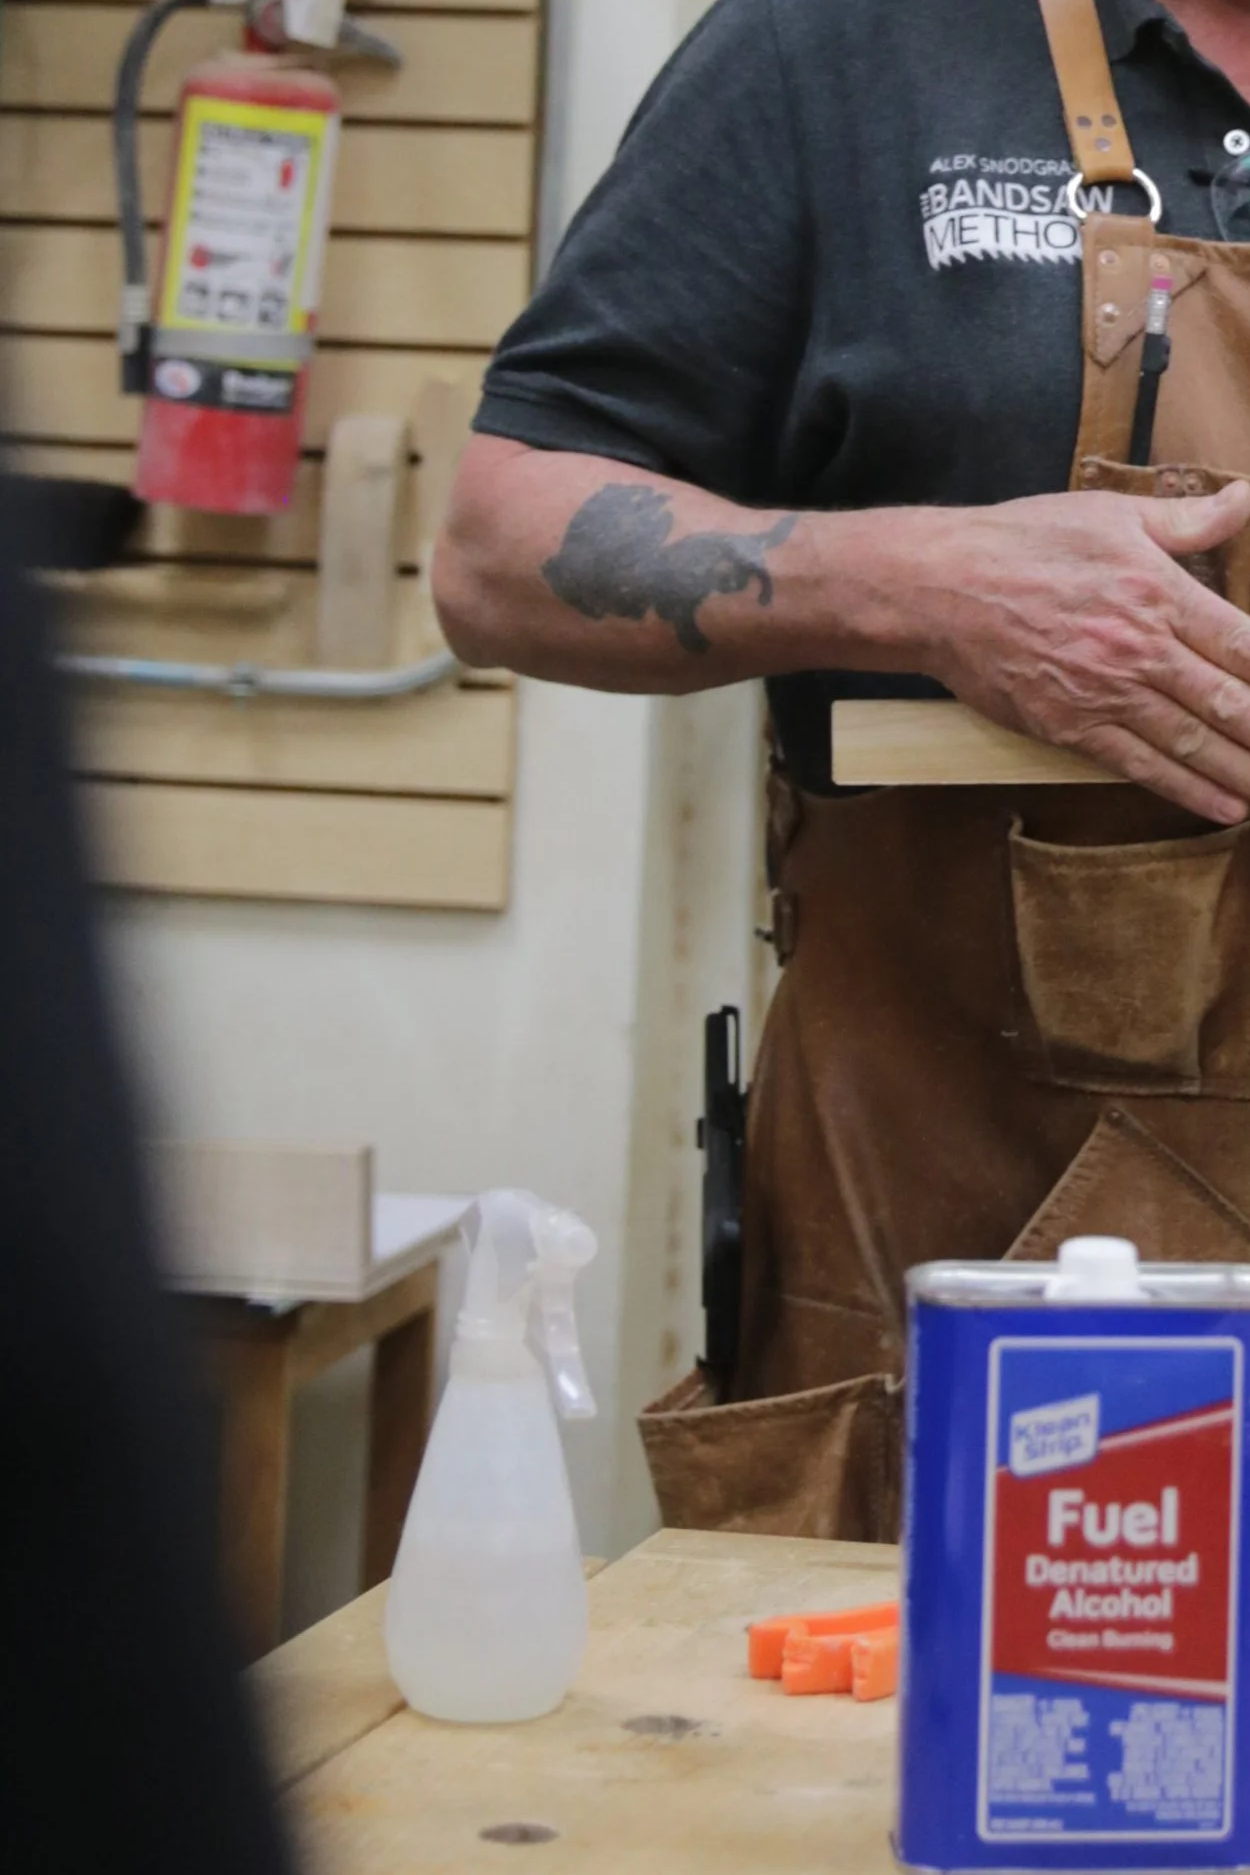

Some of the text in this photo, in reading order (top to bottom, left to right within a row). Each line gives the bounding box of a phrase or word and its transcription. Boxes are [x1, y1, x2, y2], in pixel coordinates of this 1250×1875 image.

[929, 154, 1078, 176] ALEX SNODGRA
[928, 178, 1114, 215] BANDSAW
[929, 213, 1078, 253] METHO
[1048, 1485, 1179, 1547] Fuel
[1026, 1552, 1199, 1586] Denatured
[1049, 1588, 1173, 1619] Alcohol
